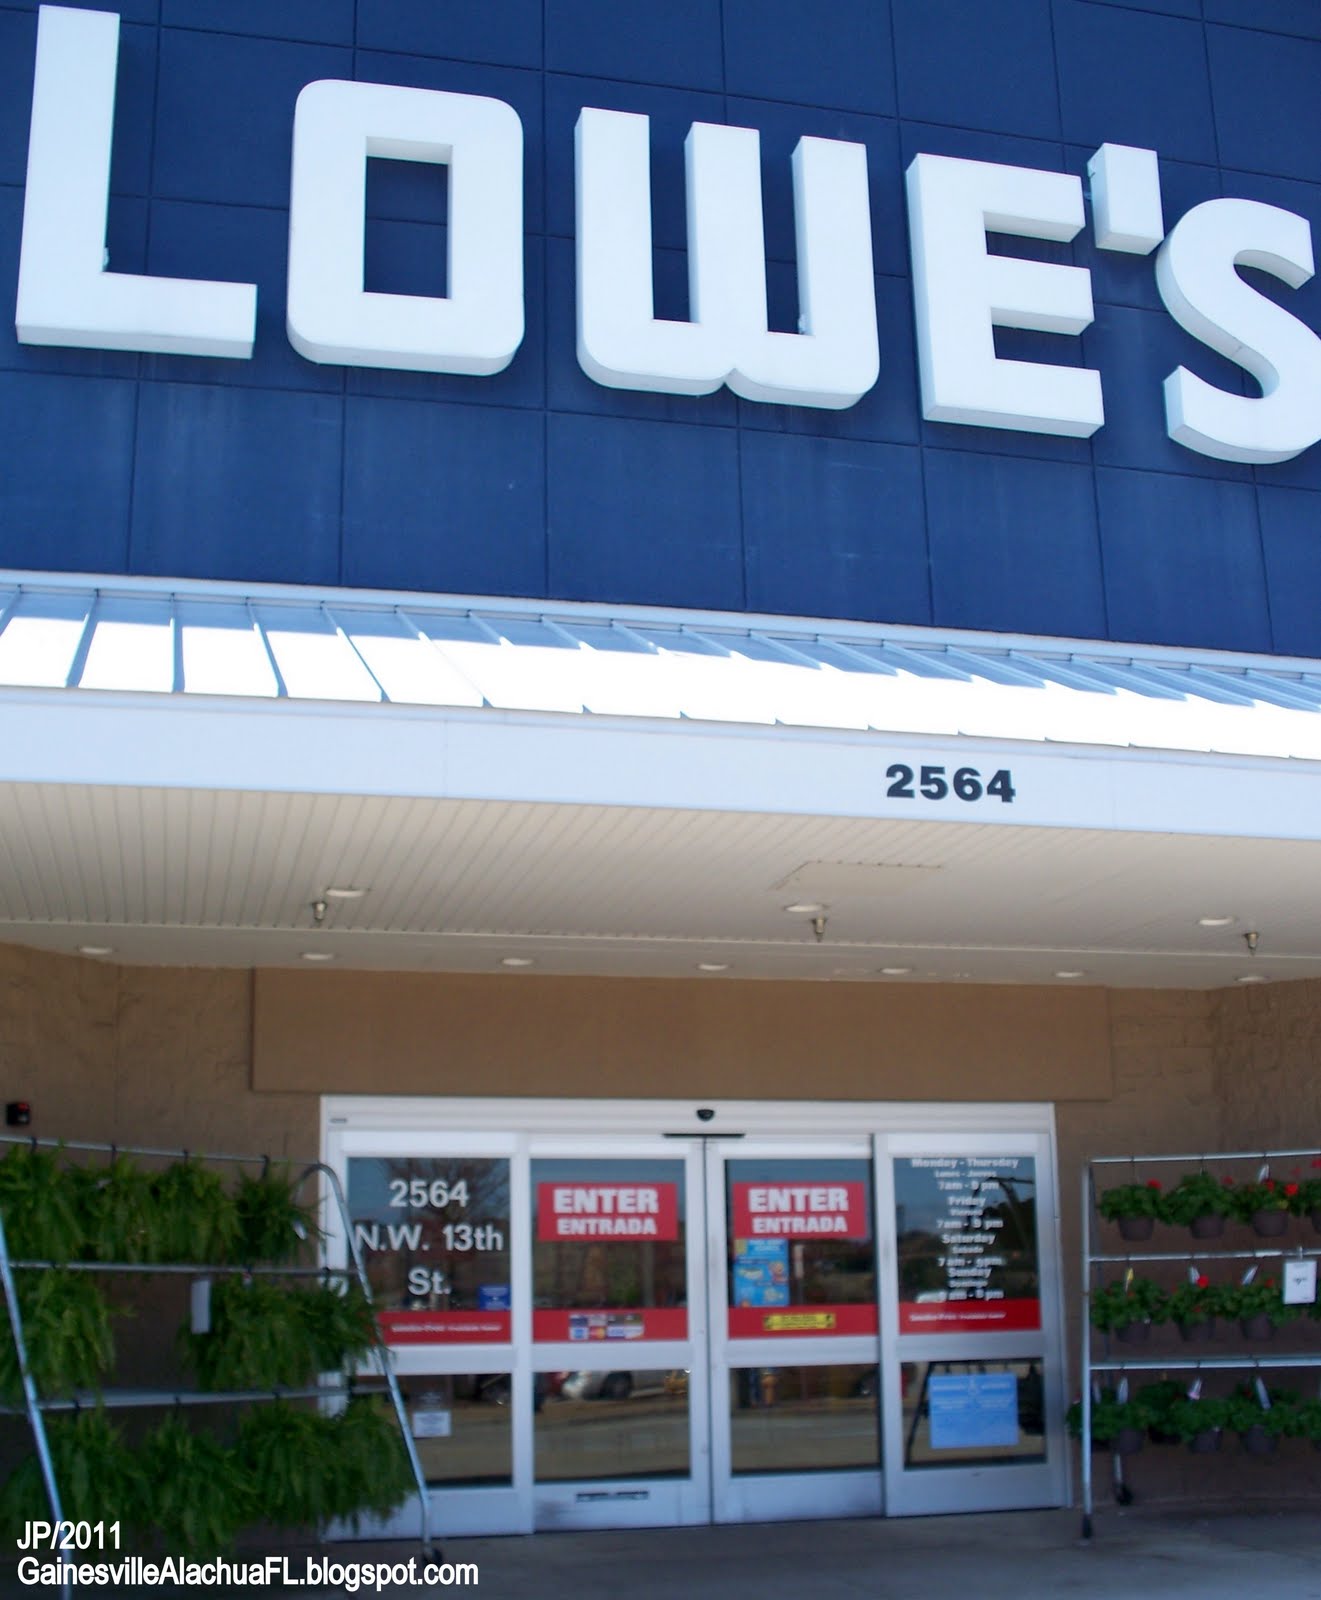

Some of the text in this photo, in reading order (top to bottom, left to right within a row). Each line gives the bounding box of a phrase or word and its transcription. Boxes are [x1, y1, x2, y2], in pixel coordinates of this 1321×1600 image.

[15, 4, 1321, 464] LOWE'S
[886, 763, 1016, 803] 2564
[389, 1179, 469, 1208] 2564
[553, 1187, 660, 1214] ENTER
[747, 1186, 849, 1213] ENTER
[947, 1197, 986, 1207] Friday
[354, 1223, 504, 1252] N.W. 13th
[556, 1217, 658, 1236] ENTRADA
[752, 1215, 848, 1235] ENTRADA
[941, 1233, 996, 1245] Saturday
[408, 1266, 452, 1296] St.
